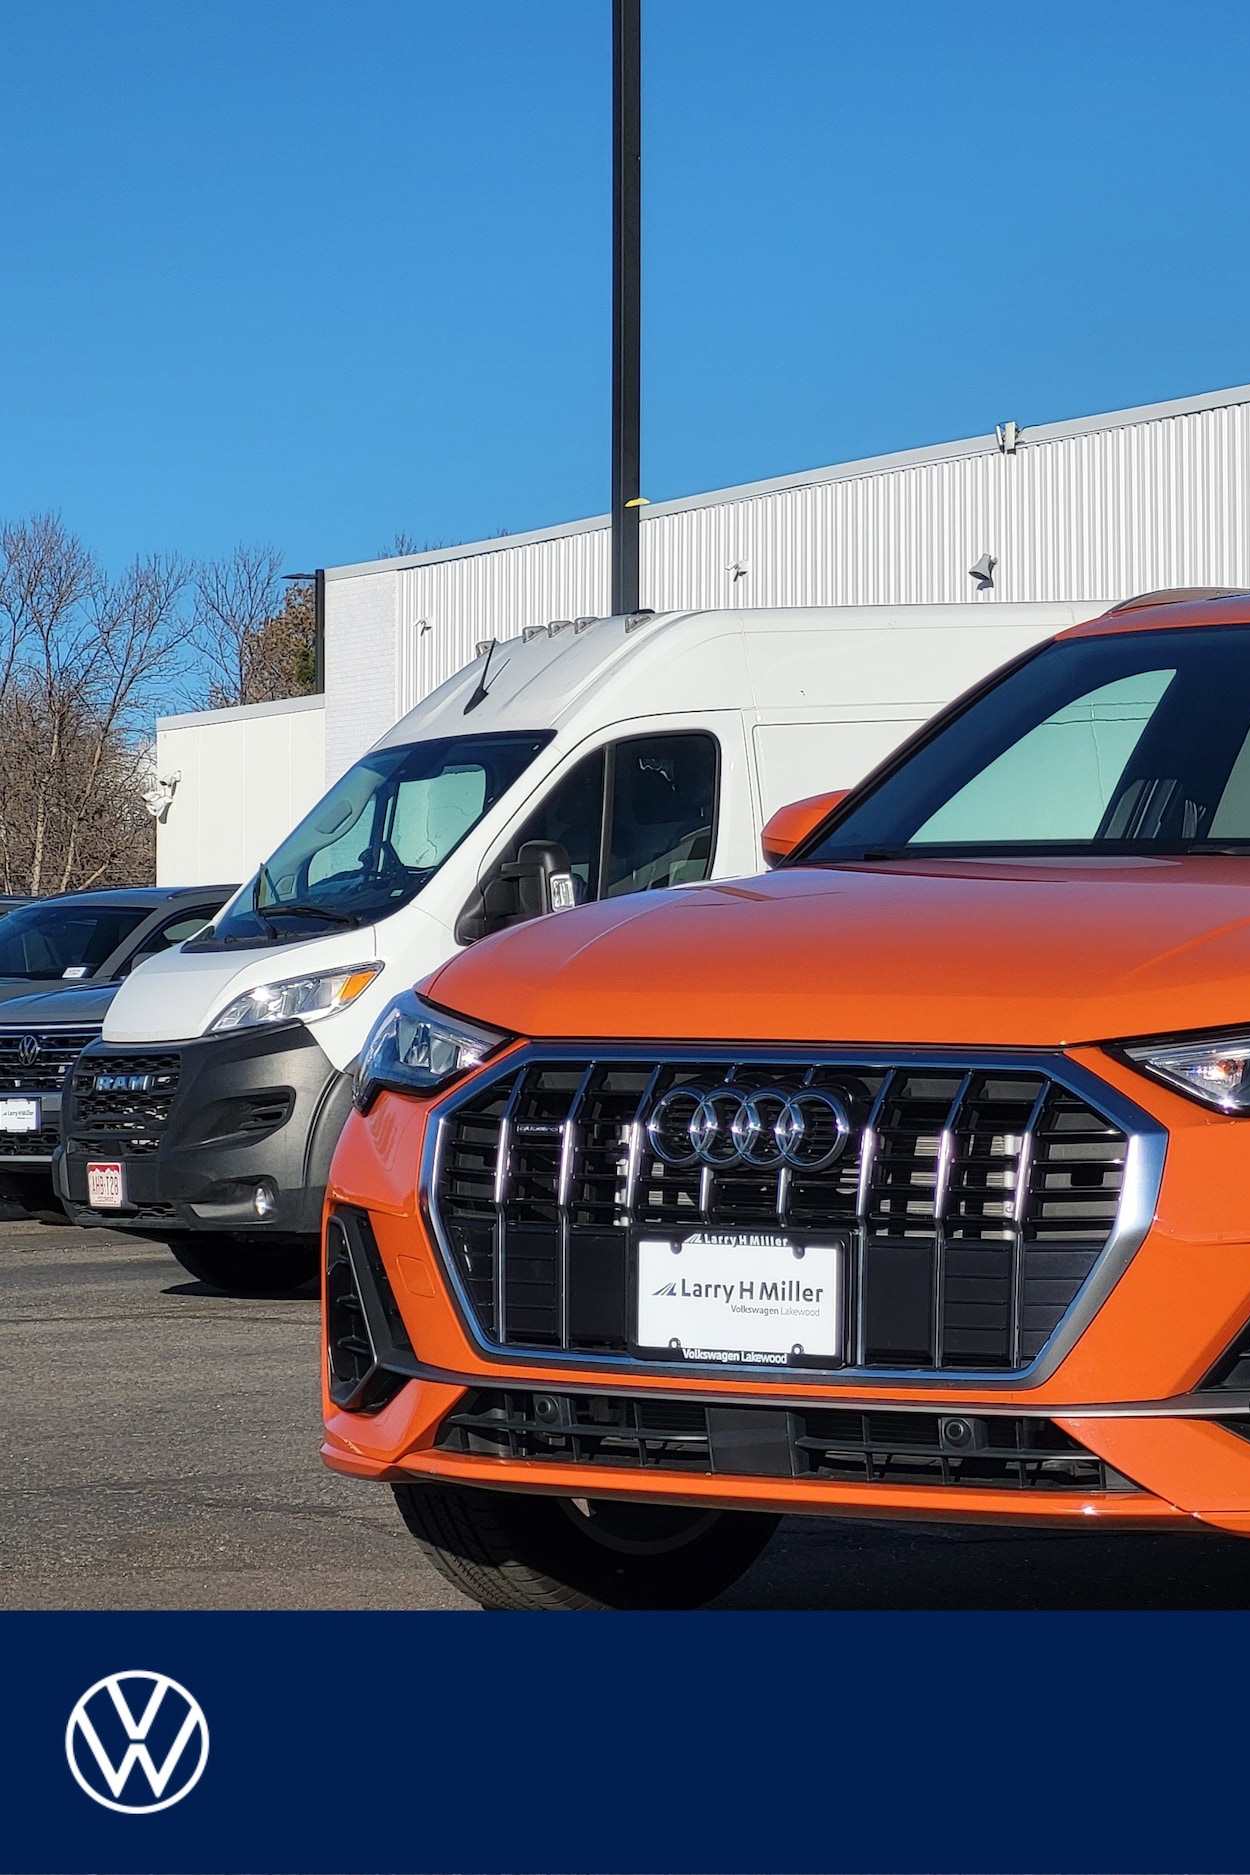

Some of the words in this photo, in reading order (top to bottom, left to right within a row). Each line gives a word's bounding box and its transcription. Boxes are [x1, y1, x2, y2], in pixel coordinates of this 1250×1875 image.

[96, 1076, 148, 1090] RAM
[704, 1233, 737, 1247] Larry
[739, 1234, 747, 1245] H
[749, 1235, 789, 1247] Miller
[681, 1278, 735, 1304] Larry
[740, 1281, 754, 1300] H
[759, 1281, 824, 1303] Miller
[730, 1304, 779, 1316] Volkswagen
[780, 1306, 820, 1317] Lakewood
[682, 1348, 740, 1363] Volkswagen
[741, 1351, 788, 1365] Lakewood
